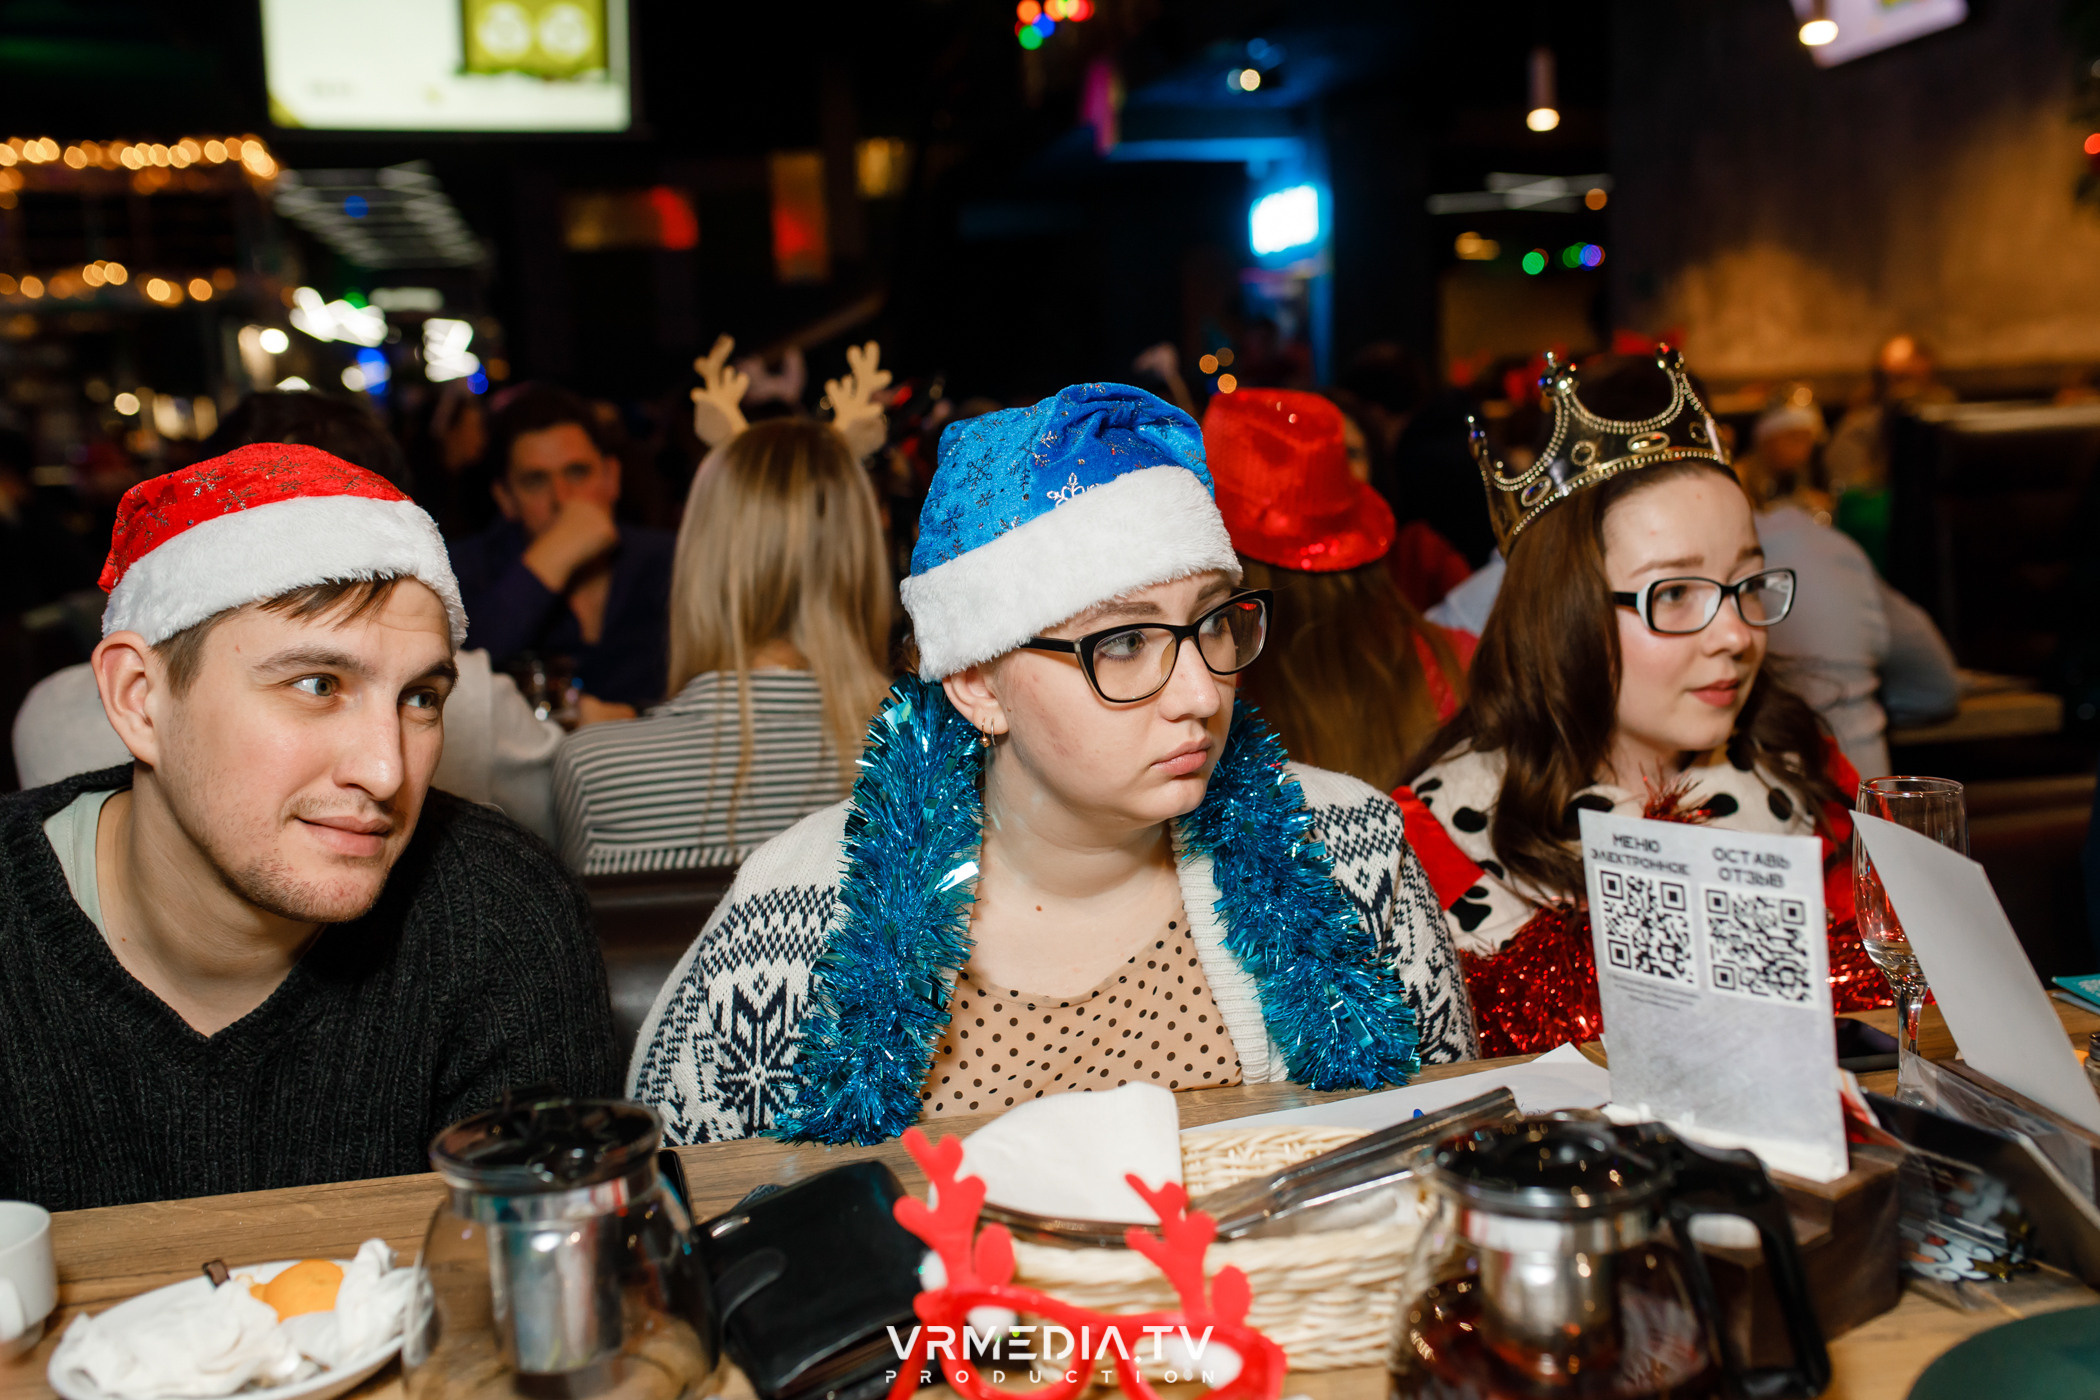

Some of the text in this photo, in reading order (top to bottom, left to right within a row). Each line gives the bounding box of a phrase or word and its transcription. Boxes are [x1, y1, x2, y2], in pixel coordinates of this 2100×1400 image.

[1612, 834, 1661, 853] МЕНЮ
[1591, 849, 1690, 876] ЭЛЕКТРОННОЕ
[1712, 846, 1792, 870] ОСТАВЬ
[1718, 867, 1785, 888] ОТЗЫВ
